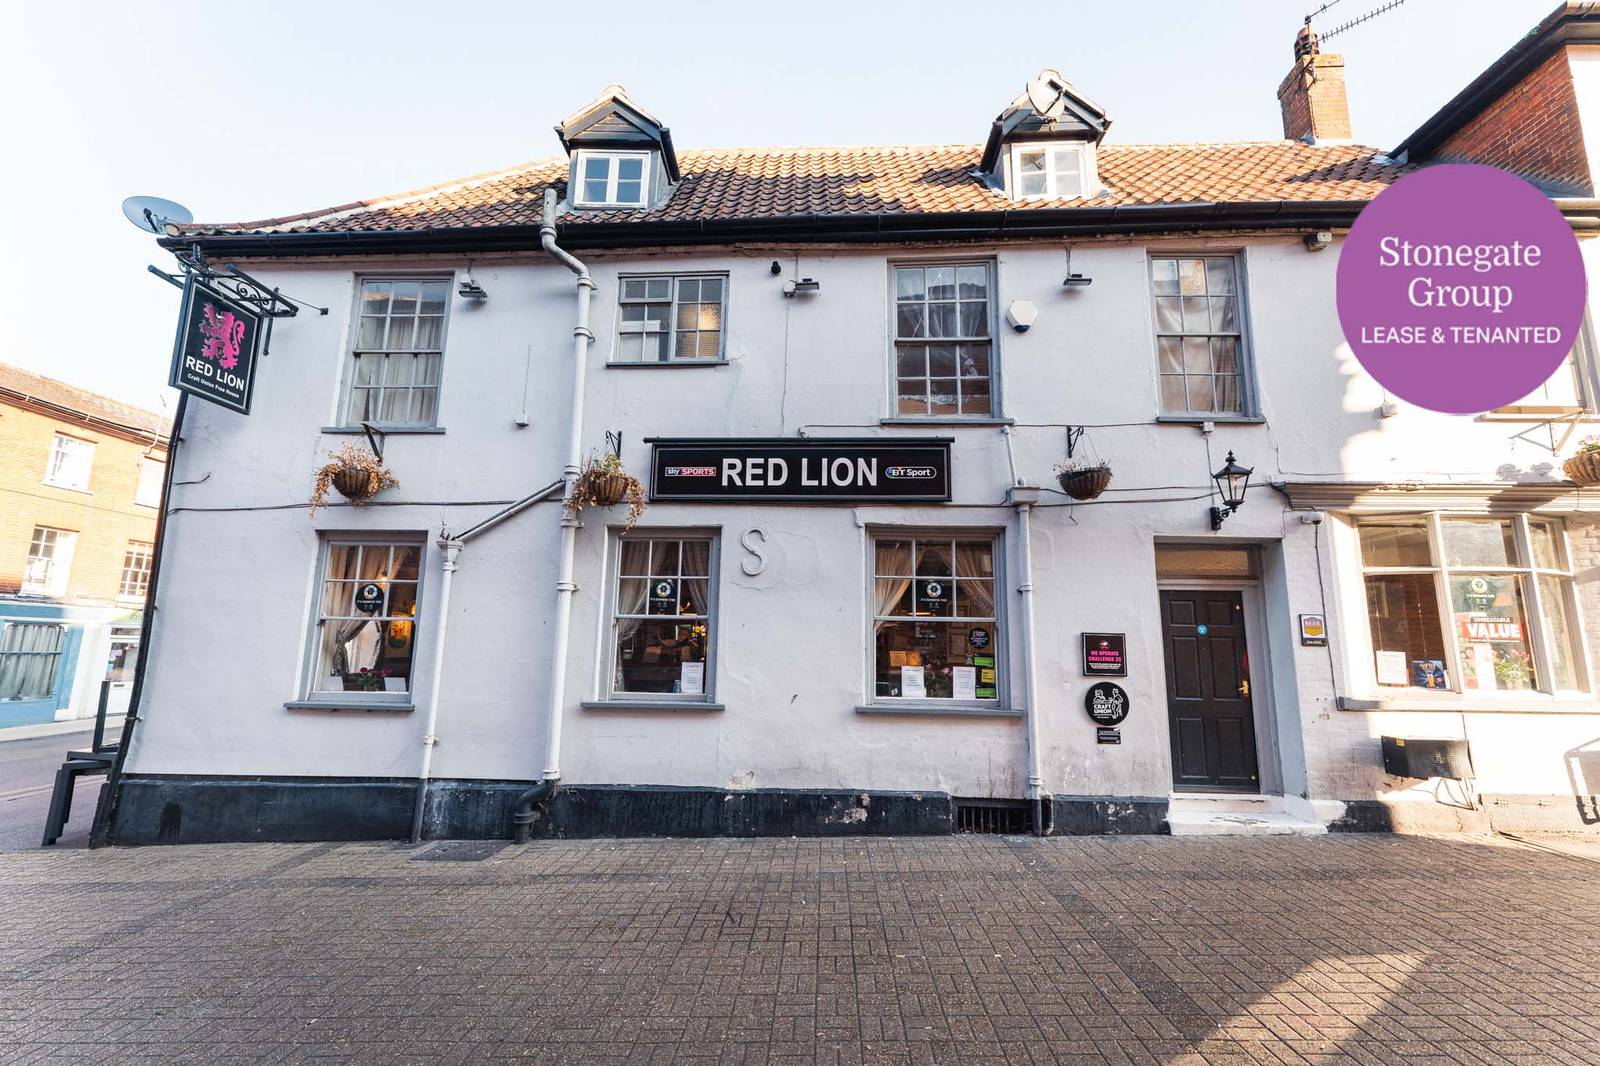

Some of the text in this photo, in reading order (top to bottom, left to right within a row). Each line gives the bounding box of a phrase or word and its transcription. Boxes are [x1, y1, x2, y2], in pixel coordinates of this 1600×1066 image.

[186, 357, 245, 391] RED LION
[187, 373, 200, 381] Craft
[667, 467, 680, 475] sky
[721, 457, 878, 486] RED LION
[906, 468, 931, 477] Sport
[1466, 623, 1520, 638] VALUE
